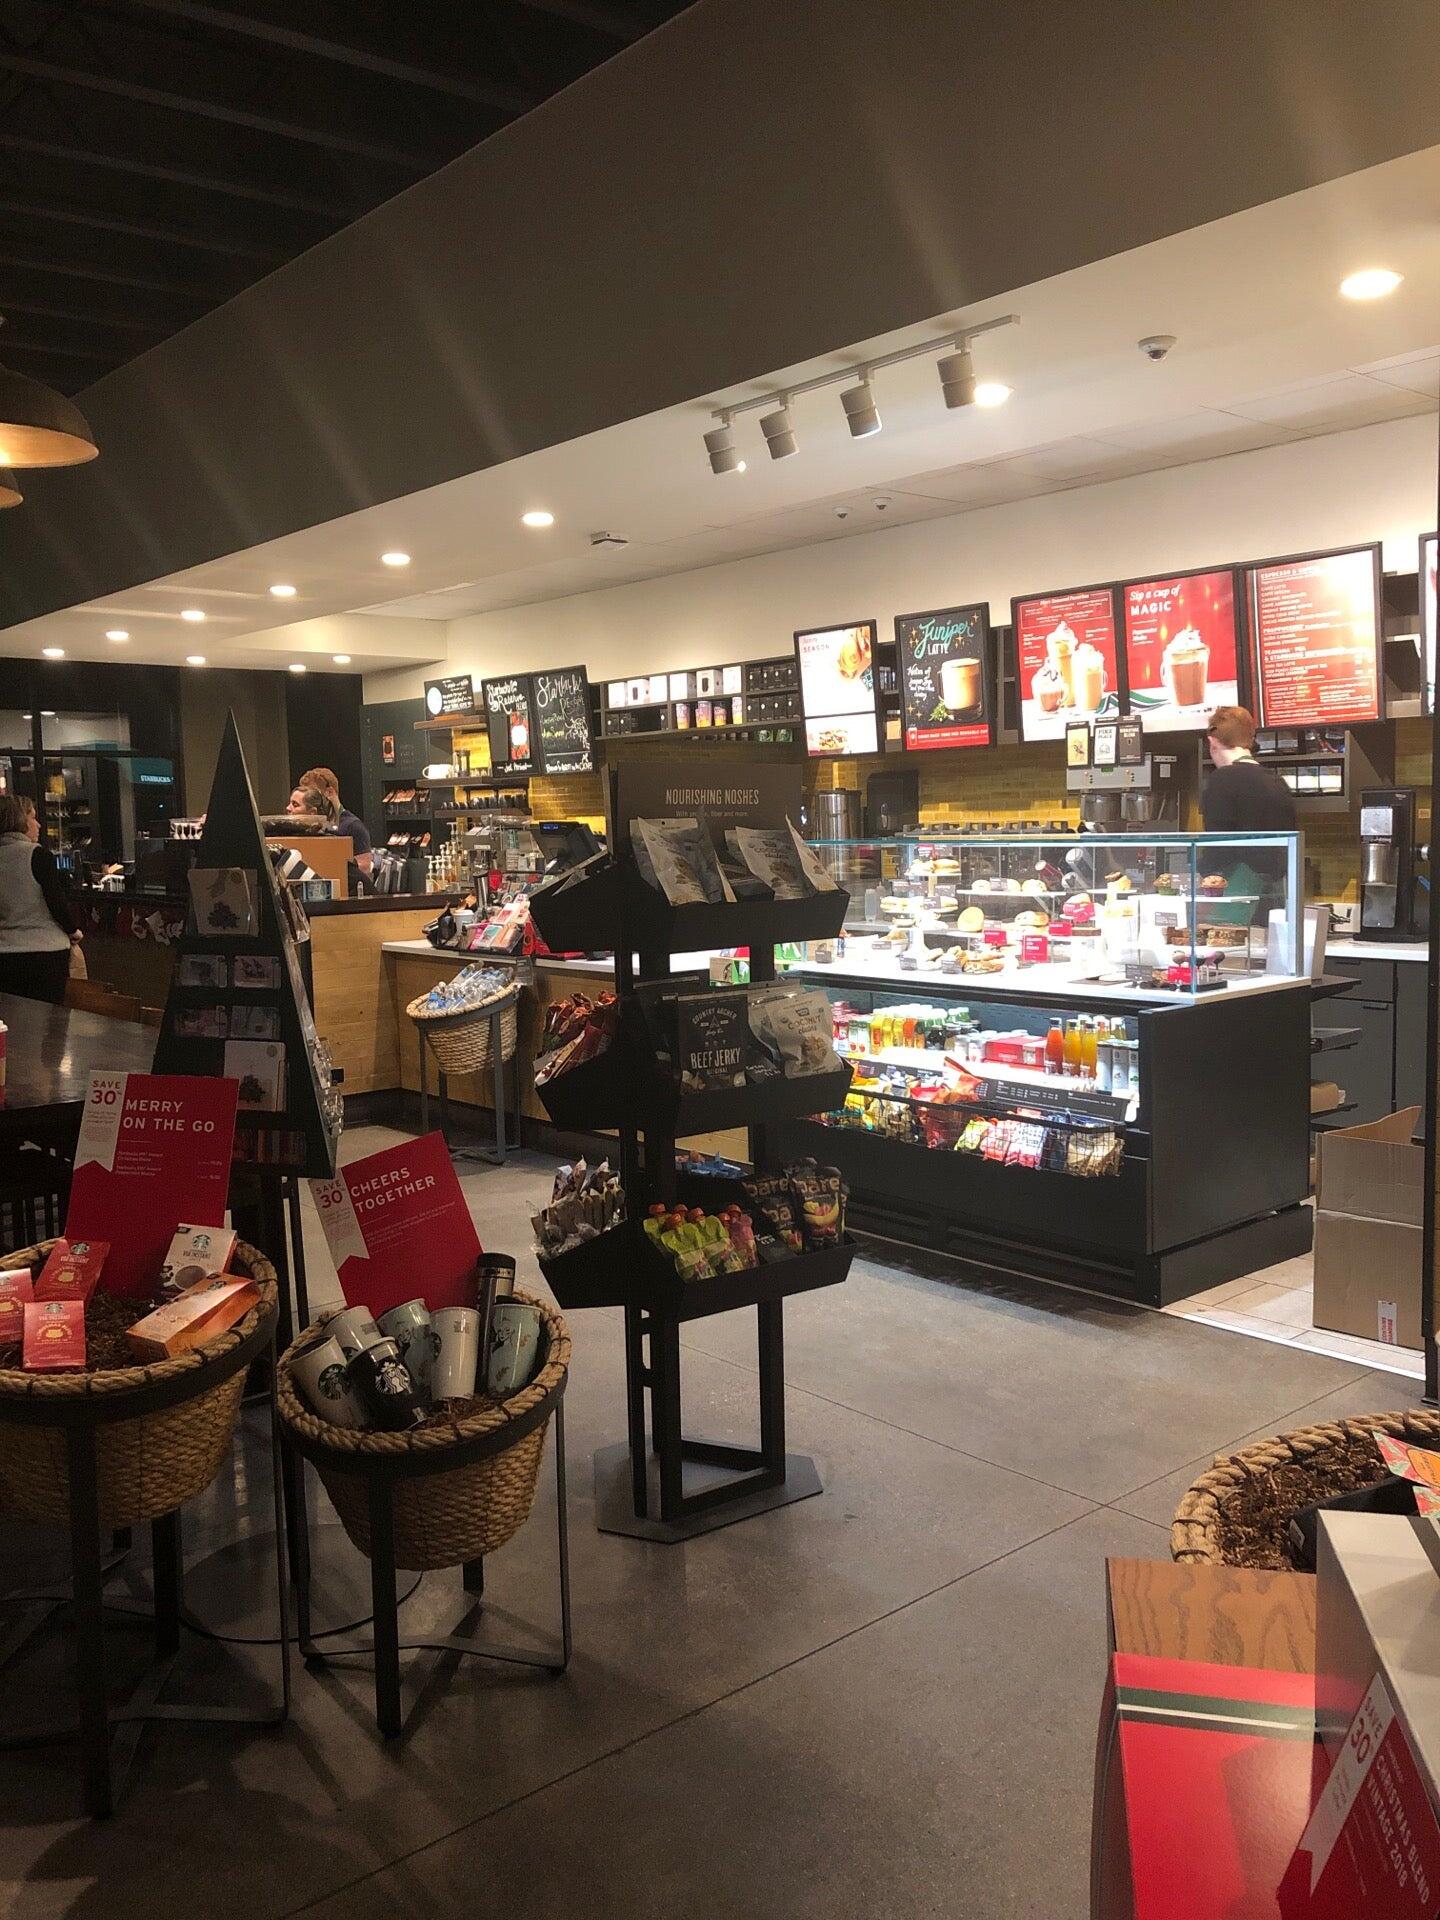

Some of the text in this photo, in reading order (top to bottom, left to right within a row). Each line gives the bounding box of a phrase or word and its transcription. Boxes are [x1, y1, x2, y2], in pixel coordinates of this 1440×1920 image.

[1130, 591, 1145, 602] Sip
[1153, 588, 1170, 599] cup
[1171, 584, 1182, 597] of
[1130, 601, 1172, 616] MAGIC
[914, 617, 975, 659] Juniper
[803, 645, 831, 653] SEASON
[927, 643, 949, 656] LATTE
[140, 775, 171, 783] STARBUCKS
[666, 788, 759, 805] NOURISHING NOSHES
[692, 1008, 715, 1025] COUNTRY
[717, 1007, 737, 1020] ARCHER
[788, 1014, 821, 1030] COCONUT
[690, 1047, 741, 1069] BEEF JERKY
[92, 1080, 121, 1089] SAVE
[125, 1099, 184, 1113] MERRY
[123, 1116, 146, 1129] ON
[154, 1118, 186, 1131] THE
[192, 1121, 216, 1133] GO
[316, 1179, 342, 1195] SAVE
[351, 1167, 411, 1198] CHEERS
[742, 1178, 789, 1197] bare
[792, 1177, 840, 1193] bare
[355, 1175, 437, 1214] TOGETHER
[1364, 1696, 1383, 1739] SAVE
[1367, 1772, 1394, 1845] VINTAGE
[1390, 1843, 1408, 1888] 2018
[1376, 1754, 1411, 1847] CHRISTMAS
[1408, 1843, 1430, 1905] BLEND
